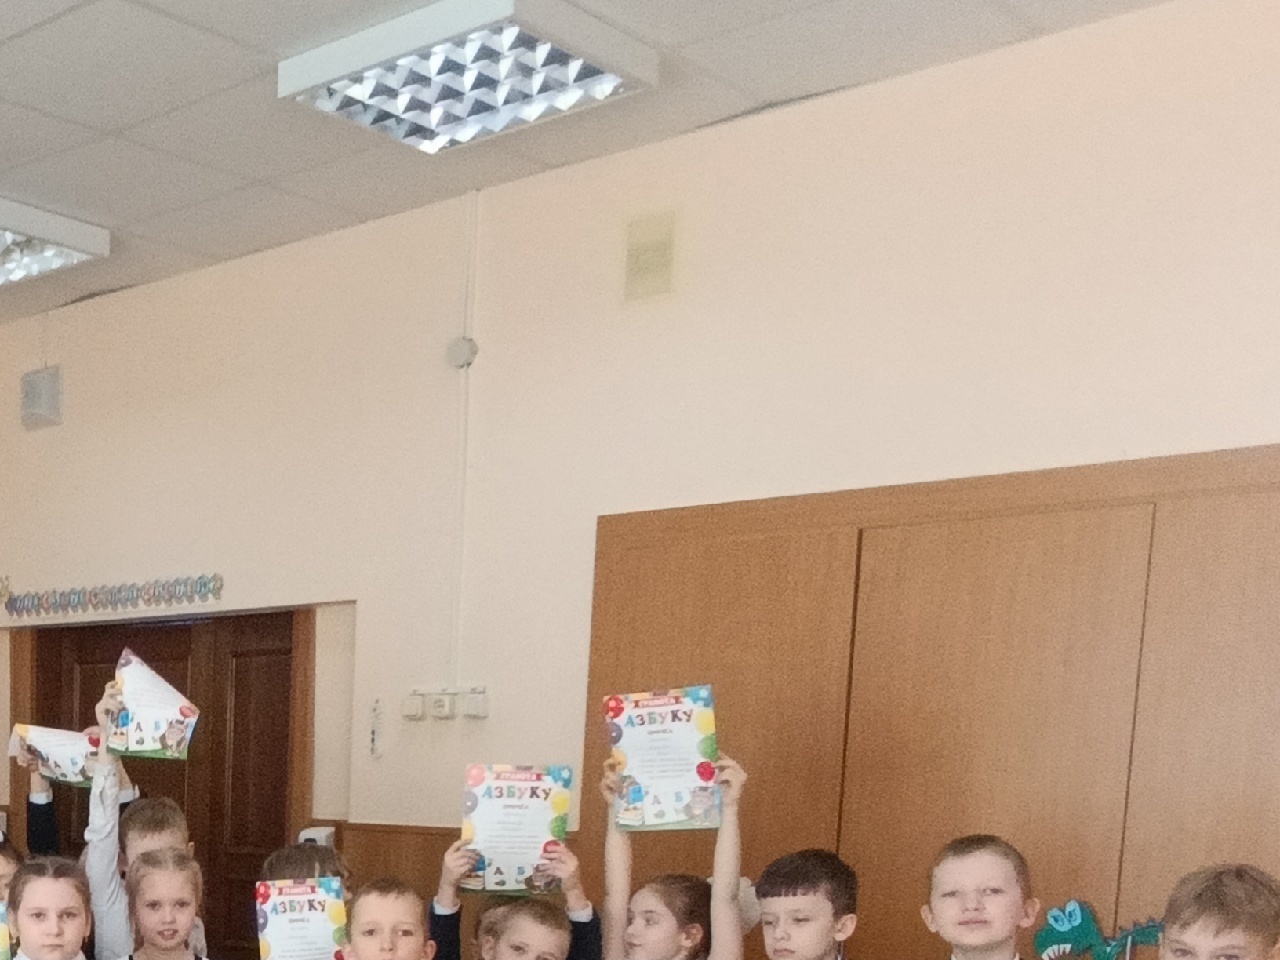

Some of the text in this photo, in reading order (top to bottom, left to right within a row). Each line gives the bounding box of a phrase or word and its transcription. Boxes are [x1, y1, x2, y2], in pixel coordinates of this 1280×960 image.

[624, 709, 694, 728] АЗБУКУ
[482, 785, 552, 801] АЗБУКУ
[270, 899, 326, 915] АЗБУКУ
